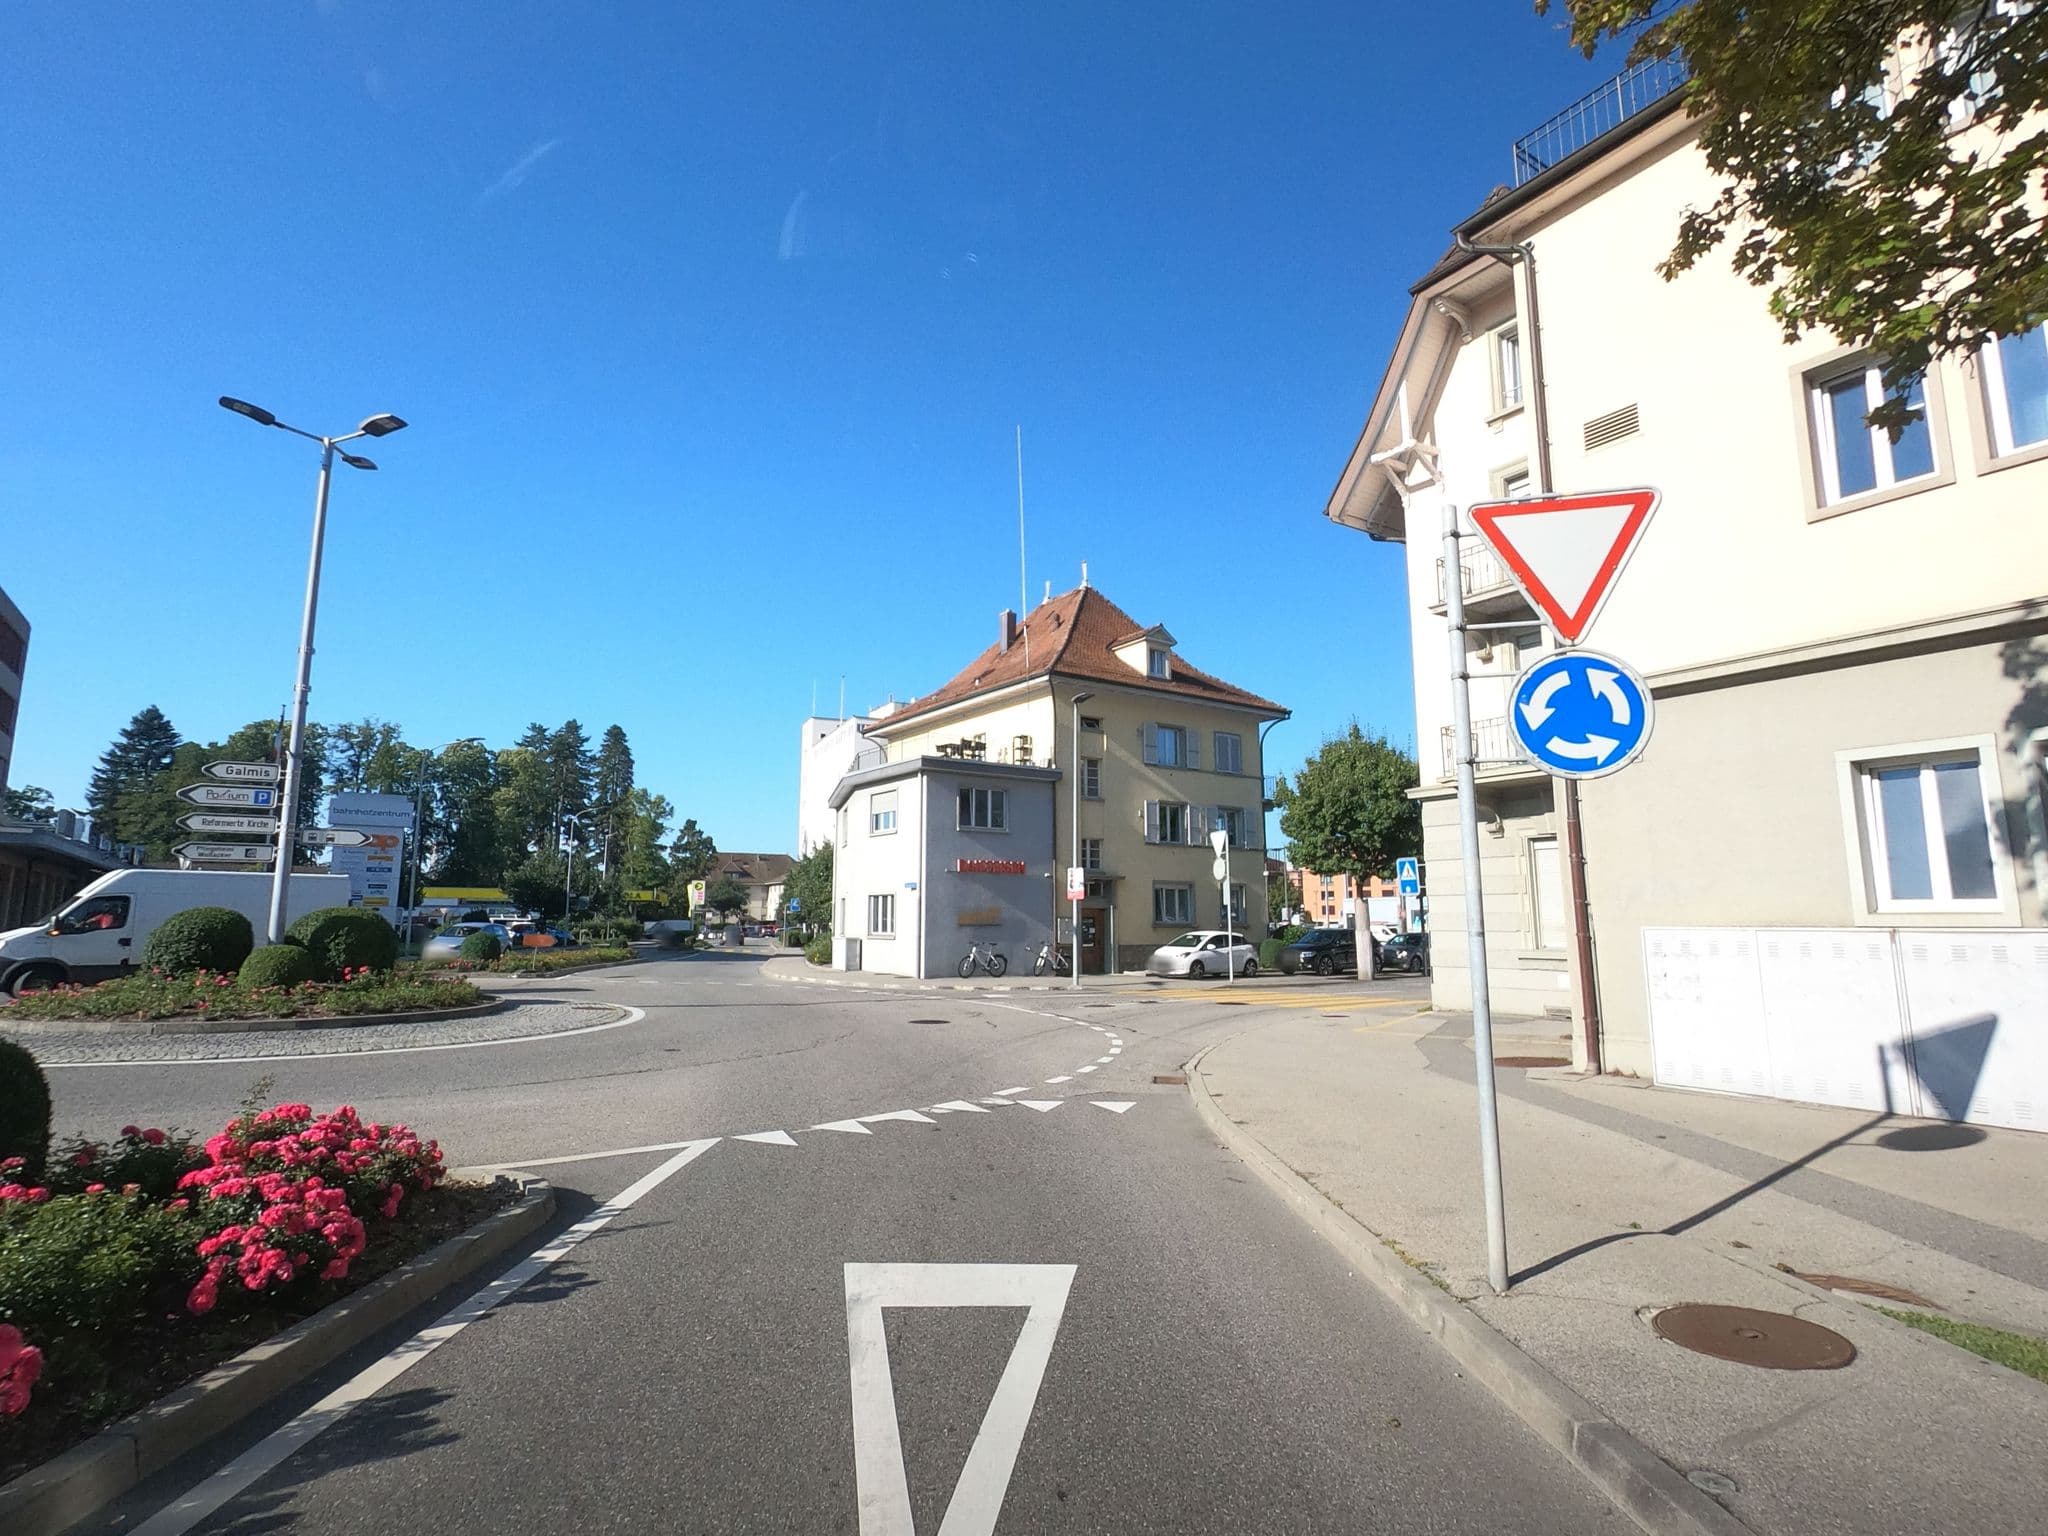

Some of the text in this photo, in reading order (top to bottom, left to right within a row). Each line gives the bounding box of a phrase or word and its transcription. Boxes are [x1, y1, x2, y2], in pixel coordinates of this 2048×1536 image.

[225, 765, 271, 777] Galmis
[258, 793, 267, 802] P
[332, 807, 410, 818] bahnhofzentrum
